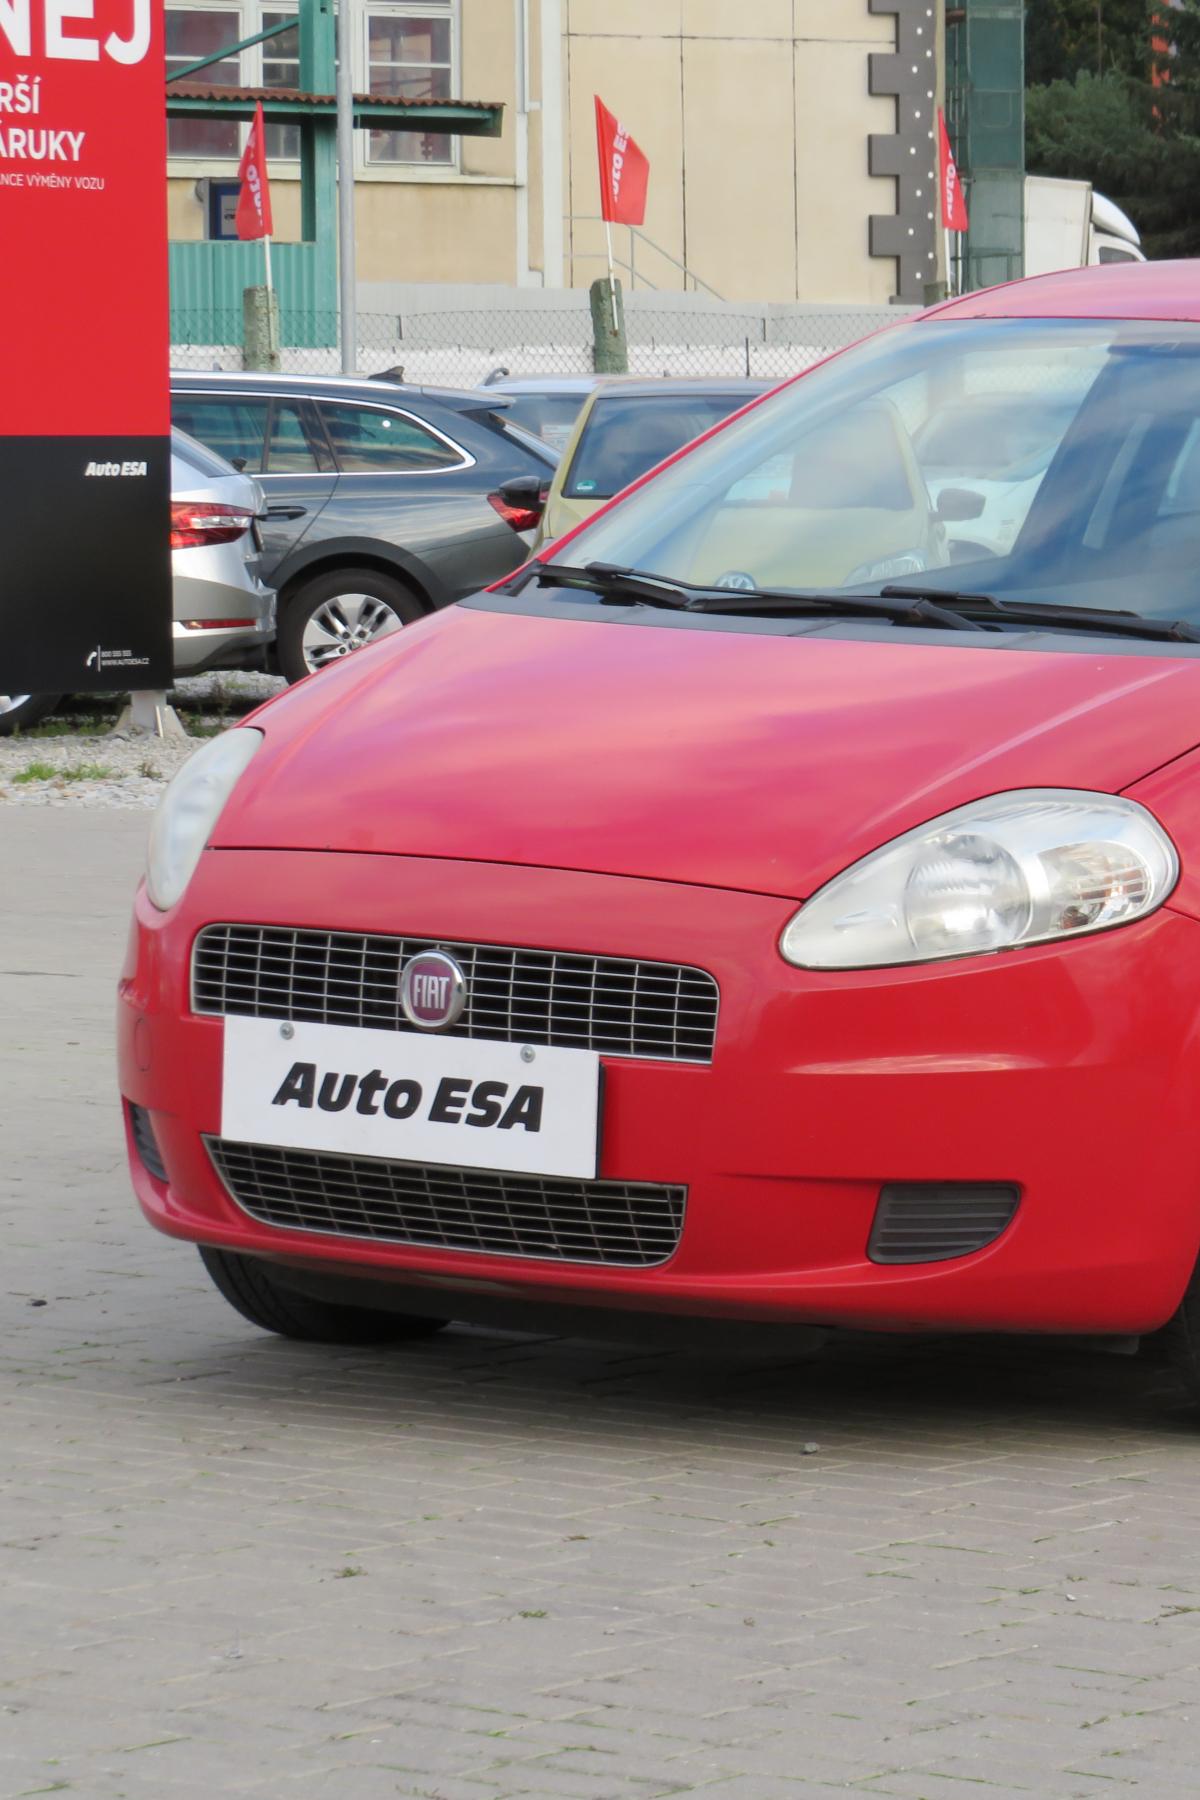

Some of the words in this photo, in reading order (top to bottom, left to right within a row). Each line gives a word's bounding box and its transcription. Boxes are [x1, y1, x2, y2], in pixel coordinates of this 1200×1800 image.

[74, 176, 105, 190] VOZU
[84, 462, 120, 476] Auto
[120, 462, 147, 476] ESA
[413, 974, 450, 1009] FIAT
[271, 1061, 422, 1120] Auto
[428, 1076, 544, 1132] ESA
